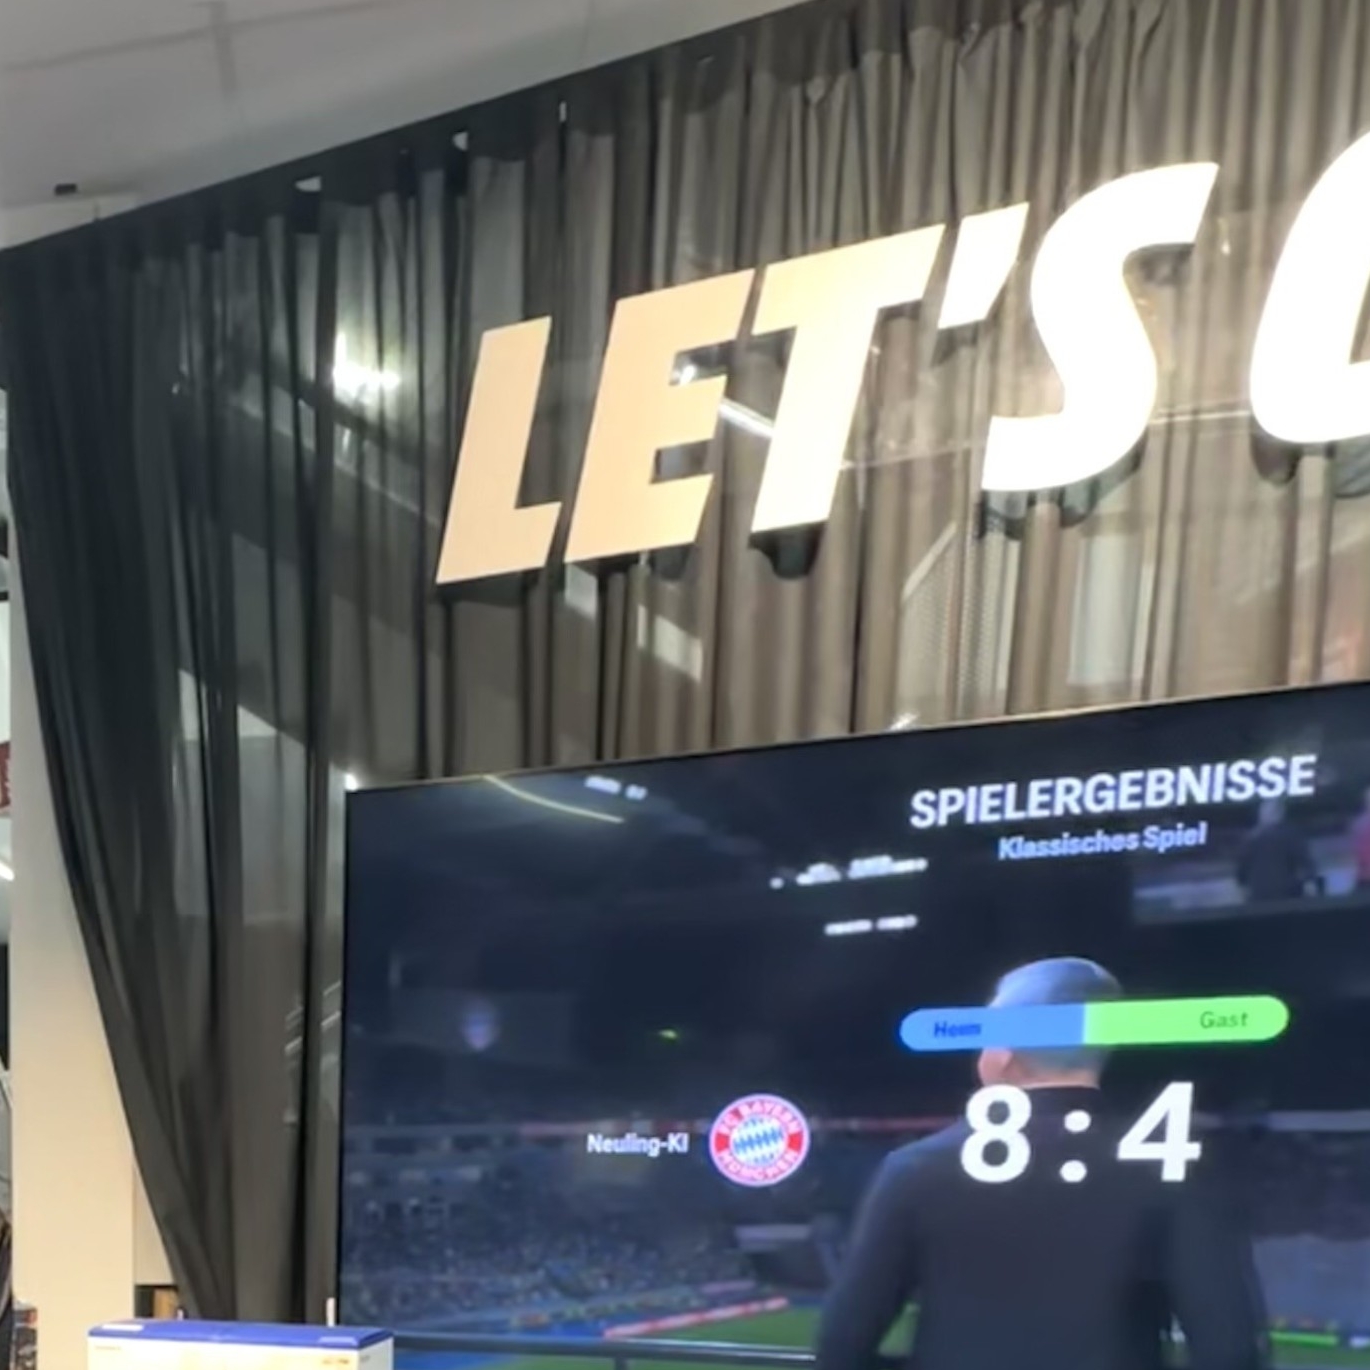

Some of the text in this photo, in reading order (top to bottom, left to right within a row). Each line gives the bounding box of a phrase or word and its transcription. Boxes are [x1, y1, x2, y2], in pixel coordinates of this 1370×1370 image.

[436, 161, 1220, 584] LET'S
[909, 754, 1318, 829] SPIELERGEBNISSE
[997, 820, 1208, 860] Klassisches Spiel
[1200, 1009, 1249, 1030] Gast
[587, 1131, 689, 1157] Neuling-KI
[959, 1083, 1033, 1183] 8
[1116, 1081, 1202, 1183] 4
